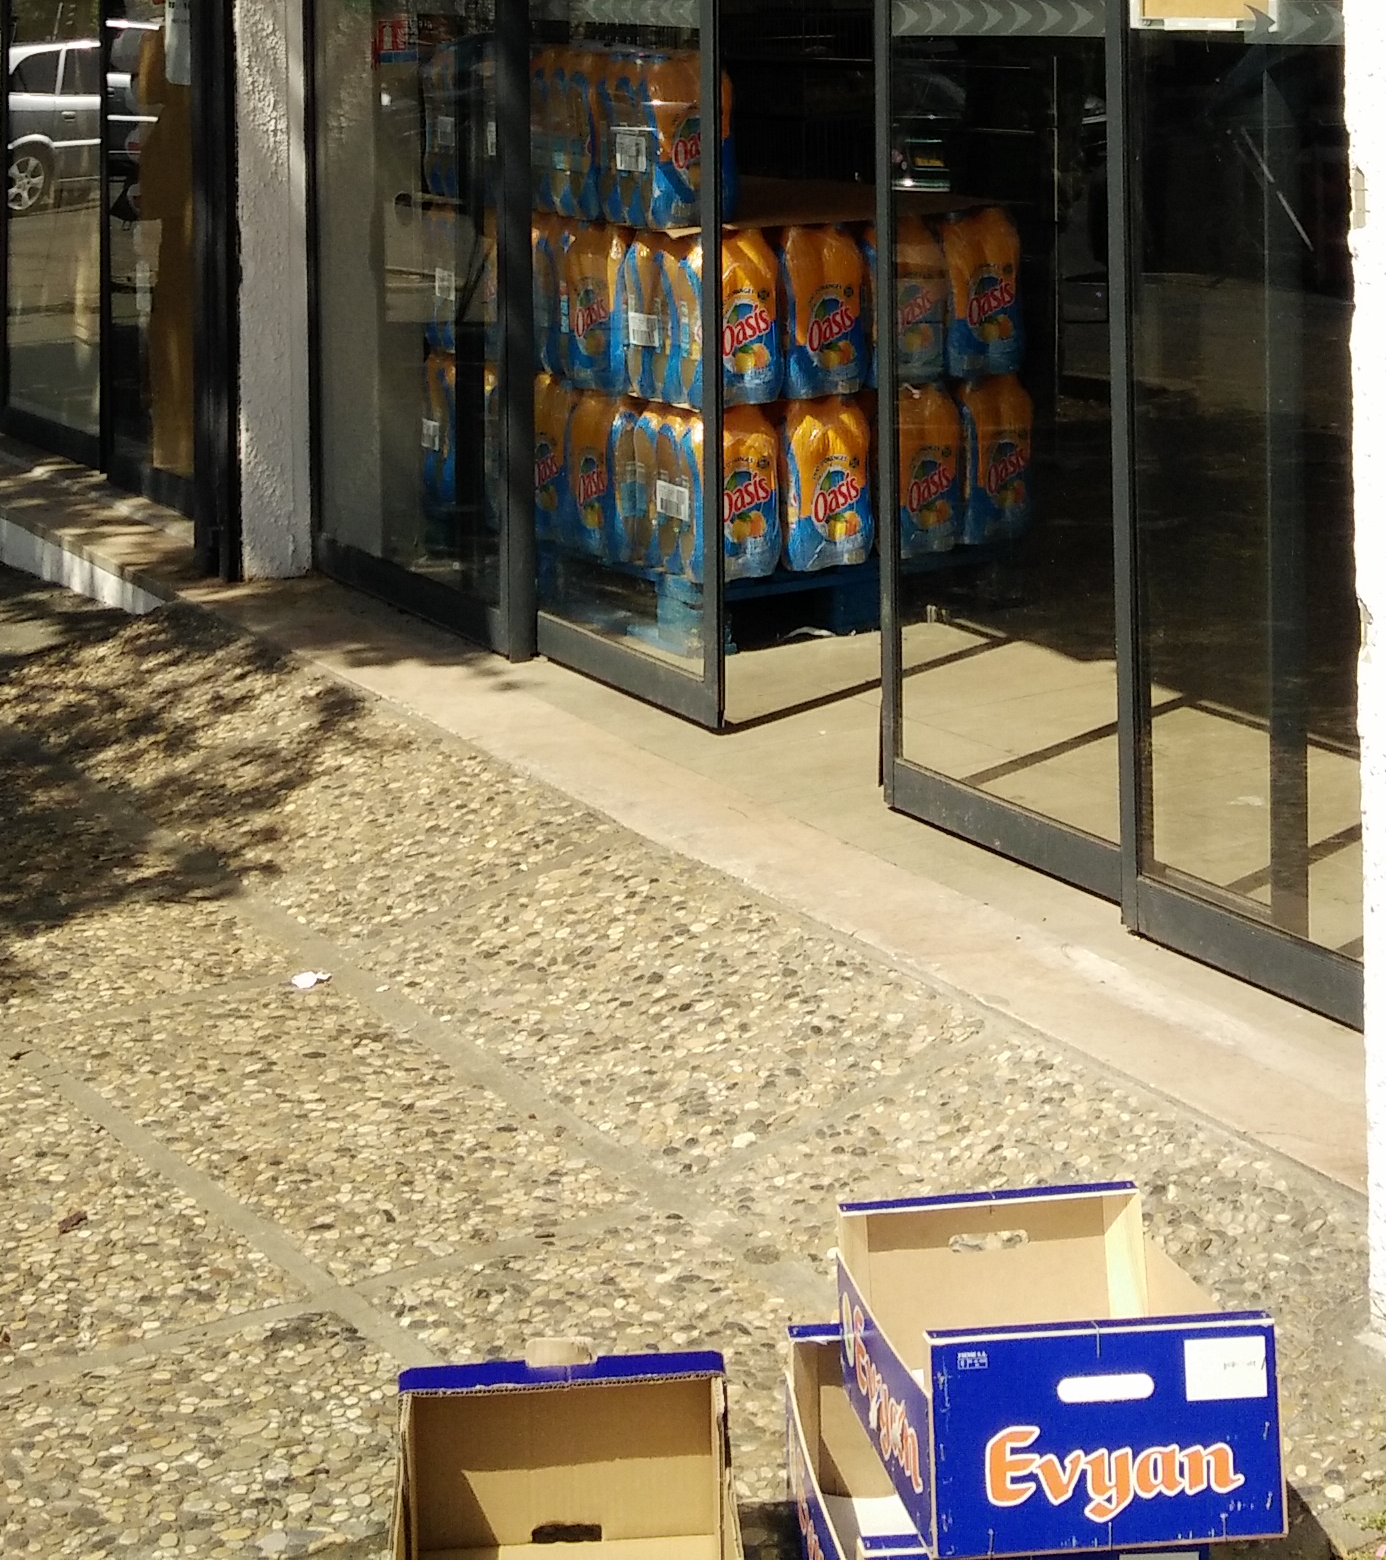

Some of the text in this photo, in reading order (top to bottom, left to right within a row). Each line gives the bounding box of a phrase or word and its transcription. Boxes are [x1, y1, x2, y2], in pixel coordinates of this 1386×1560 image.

[807, 302, 855, 351] Oasis
[968, 278, 1015, 328] Oasis
[722, 305, 770, 357] Oasis
[723, 472, 770, 523] Oasis
[813, 471, 860, 523] Oasis
[908, 462, 952, 513] Oasis
[985, 1426, 1245, 1523] Evyan
